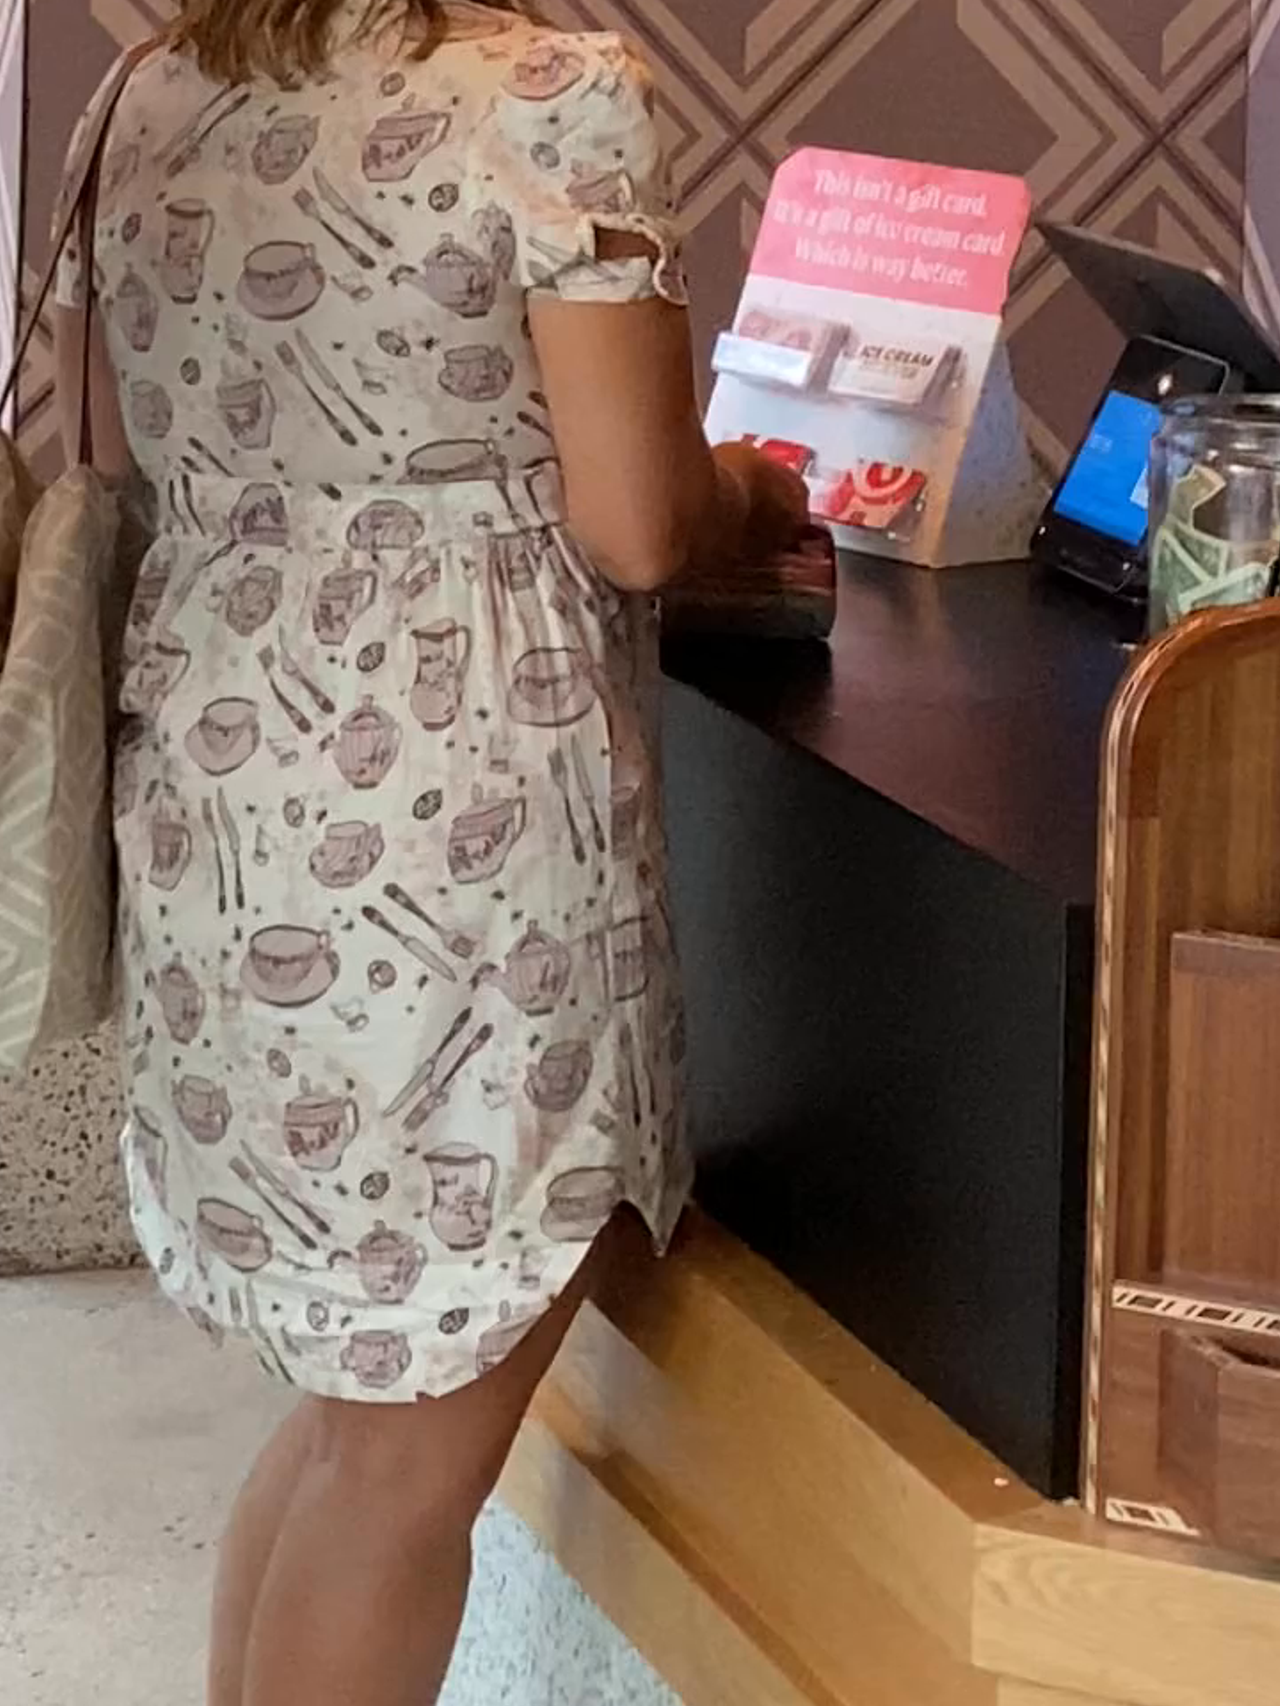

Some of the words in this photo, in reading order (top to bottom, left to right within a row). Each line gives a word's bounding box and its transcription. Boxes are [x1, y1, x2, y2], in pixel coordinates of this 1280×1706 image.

[814, 169, 847, 197] This
[906, 183, 940, 214] gift
[853, 211, 876, 236] of
[903, 223, 961, 249] cream
